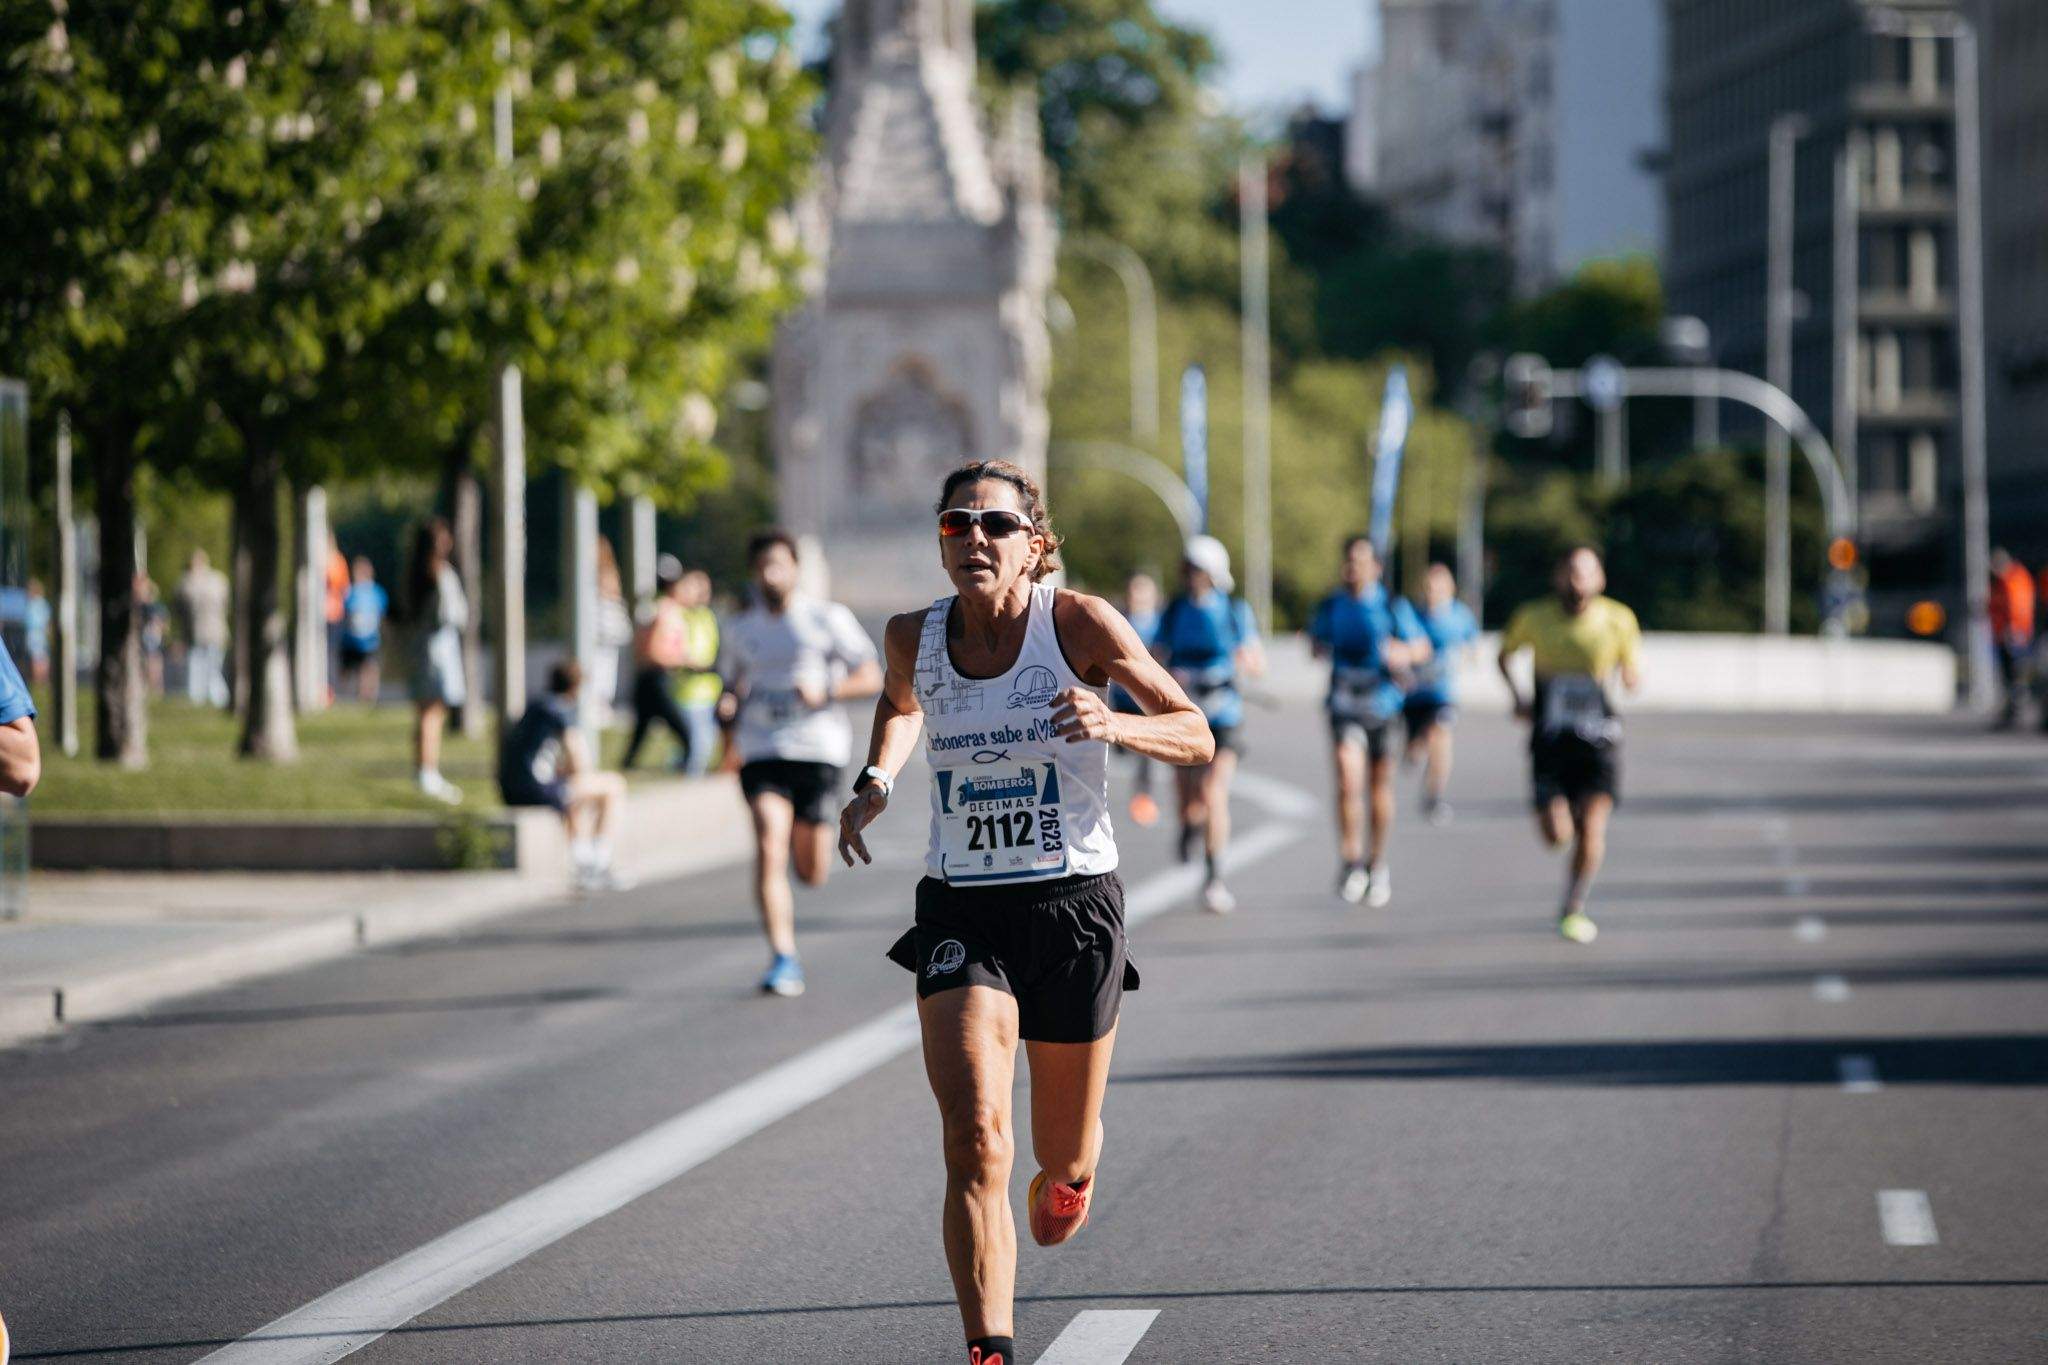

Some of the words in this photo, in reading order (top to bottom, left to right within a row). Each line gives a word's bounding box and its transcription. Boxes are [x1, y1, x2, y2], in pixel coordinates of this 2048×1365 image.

[991, 724, 1023, 745] sabe
[1027, 728, 1036, 741] a
[973, 777, 1034, 791] BOMBEROS
[970, 797, 1035, 812] DECIMAS
[967, 811, 1035, 851] 2112
[1039, 808, 1063, 852] 2623
